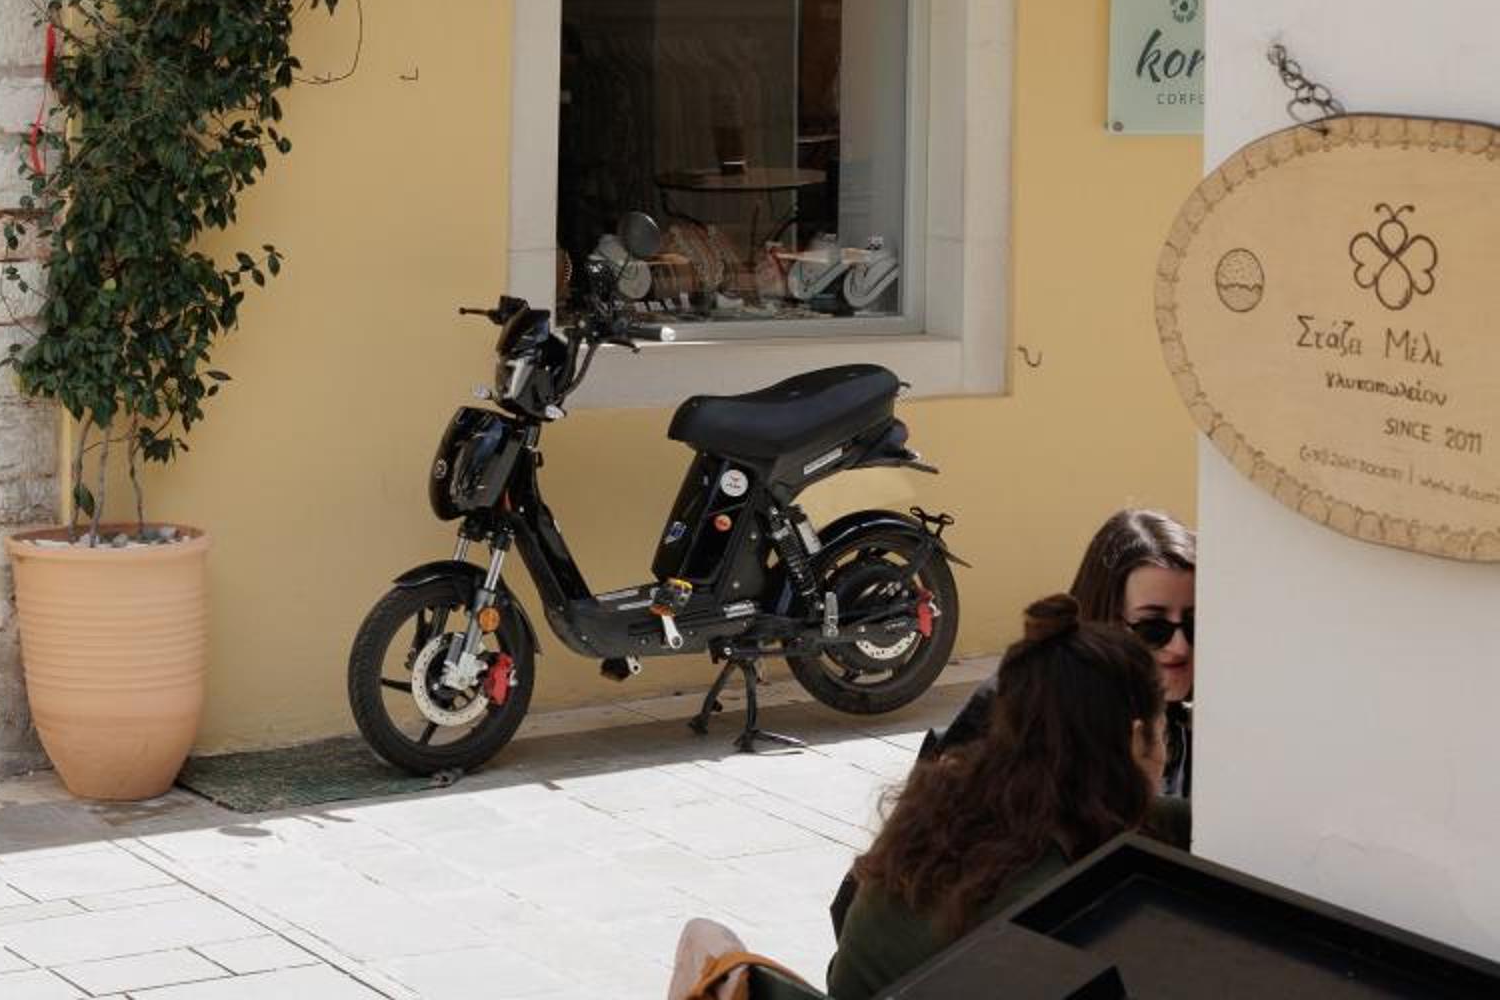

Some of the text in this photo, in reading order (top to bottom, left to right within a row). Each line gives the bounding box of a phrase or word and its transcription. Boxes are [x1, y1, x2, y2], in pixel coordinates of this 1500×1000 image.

[1384, 327, 1443, 367] Μέλι
[1383, 417, 1482, 454] SINCE 2011
